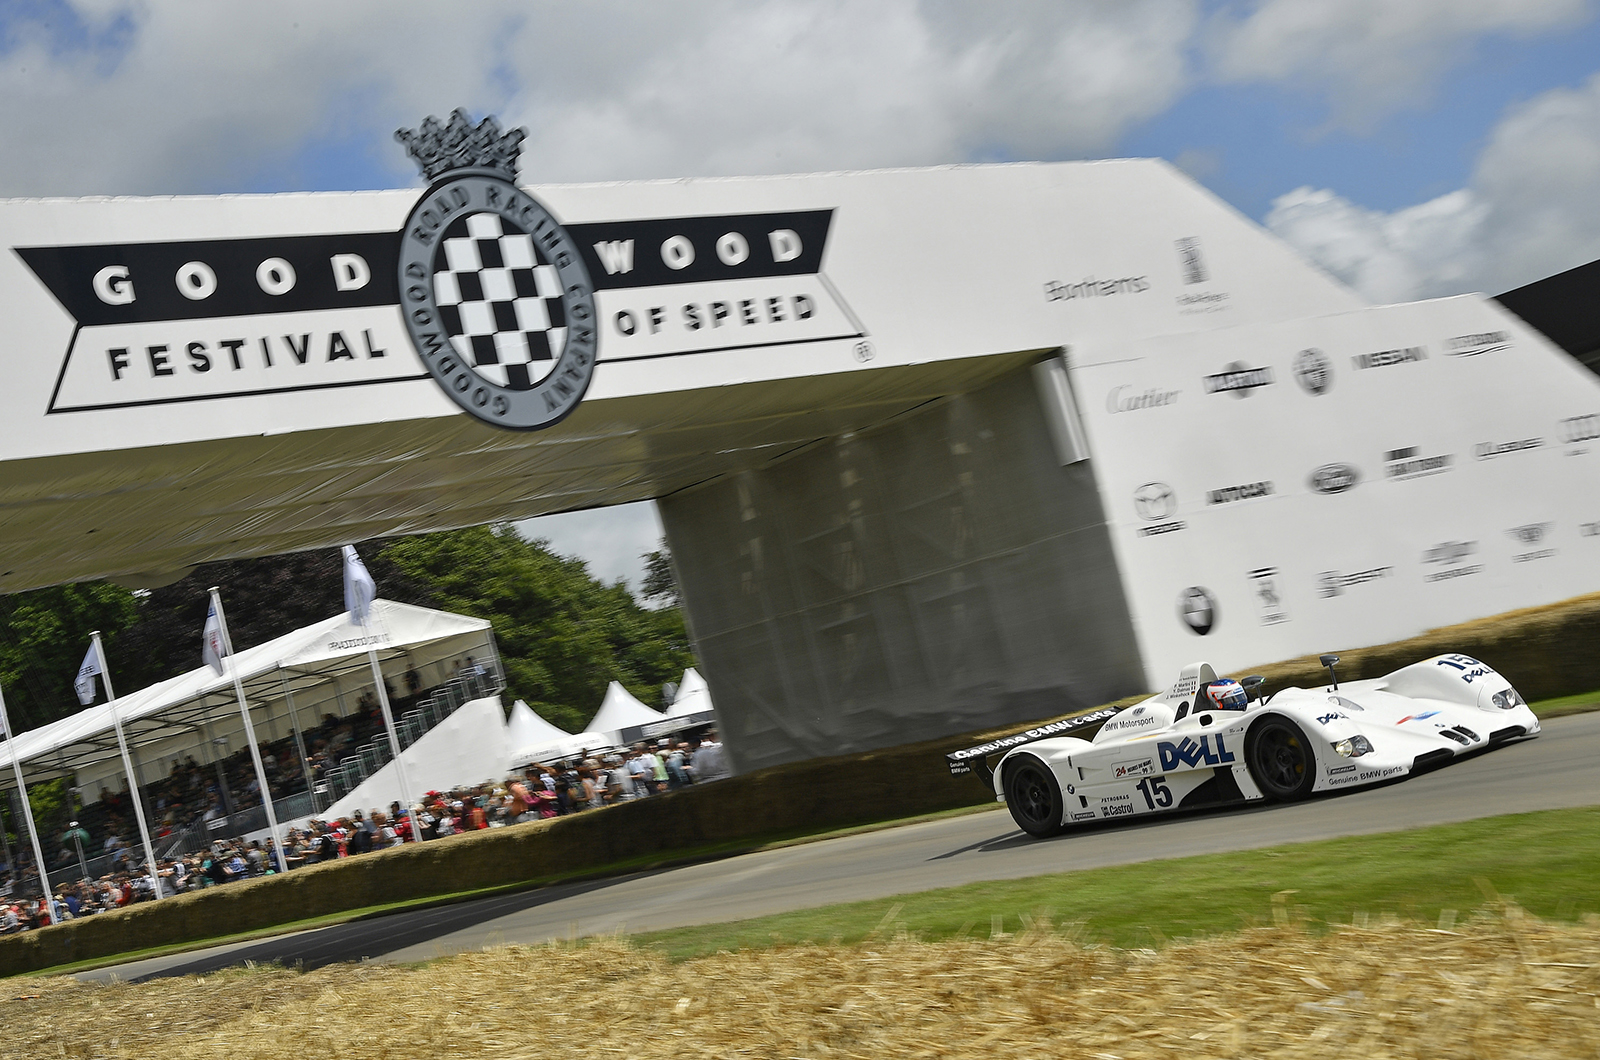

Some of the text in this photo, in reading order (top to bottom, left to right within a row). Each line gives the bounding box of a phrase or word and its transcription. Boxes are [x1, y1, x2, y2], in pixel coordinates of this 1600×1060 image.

[411, 185, 576, 270] ROAD RACING
[92, 229, 804, 306] GOOD WOOD
[108, 294, 817, 381] FESTIVAL OF SPEED
[405, 261, 511, 418] GOODWOOD
[541, 283, 593, 414] COMPANY
[1437, 654, 1480, 671] 15
[1461, 666, 1494, 684] DELL
[1104, 716, 1155, 732] BMW Motorsport
[1316, 711, 1349, 725] DELL
[1025, 720, 1073, 739] BMW
[1157, 733, 1235, 771] DELL
[1115, 766, 1126, 777] 24
[1329, 765, 1403, 785] Genuine BMW parts
[1136, 776, 1173, 811] 15
[1110, 803, 1134, 816] Castrol
